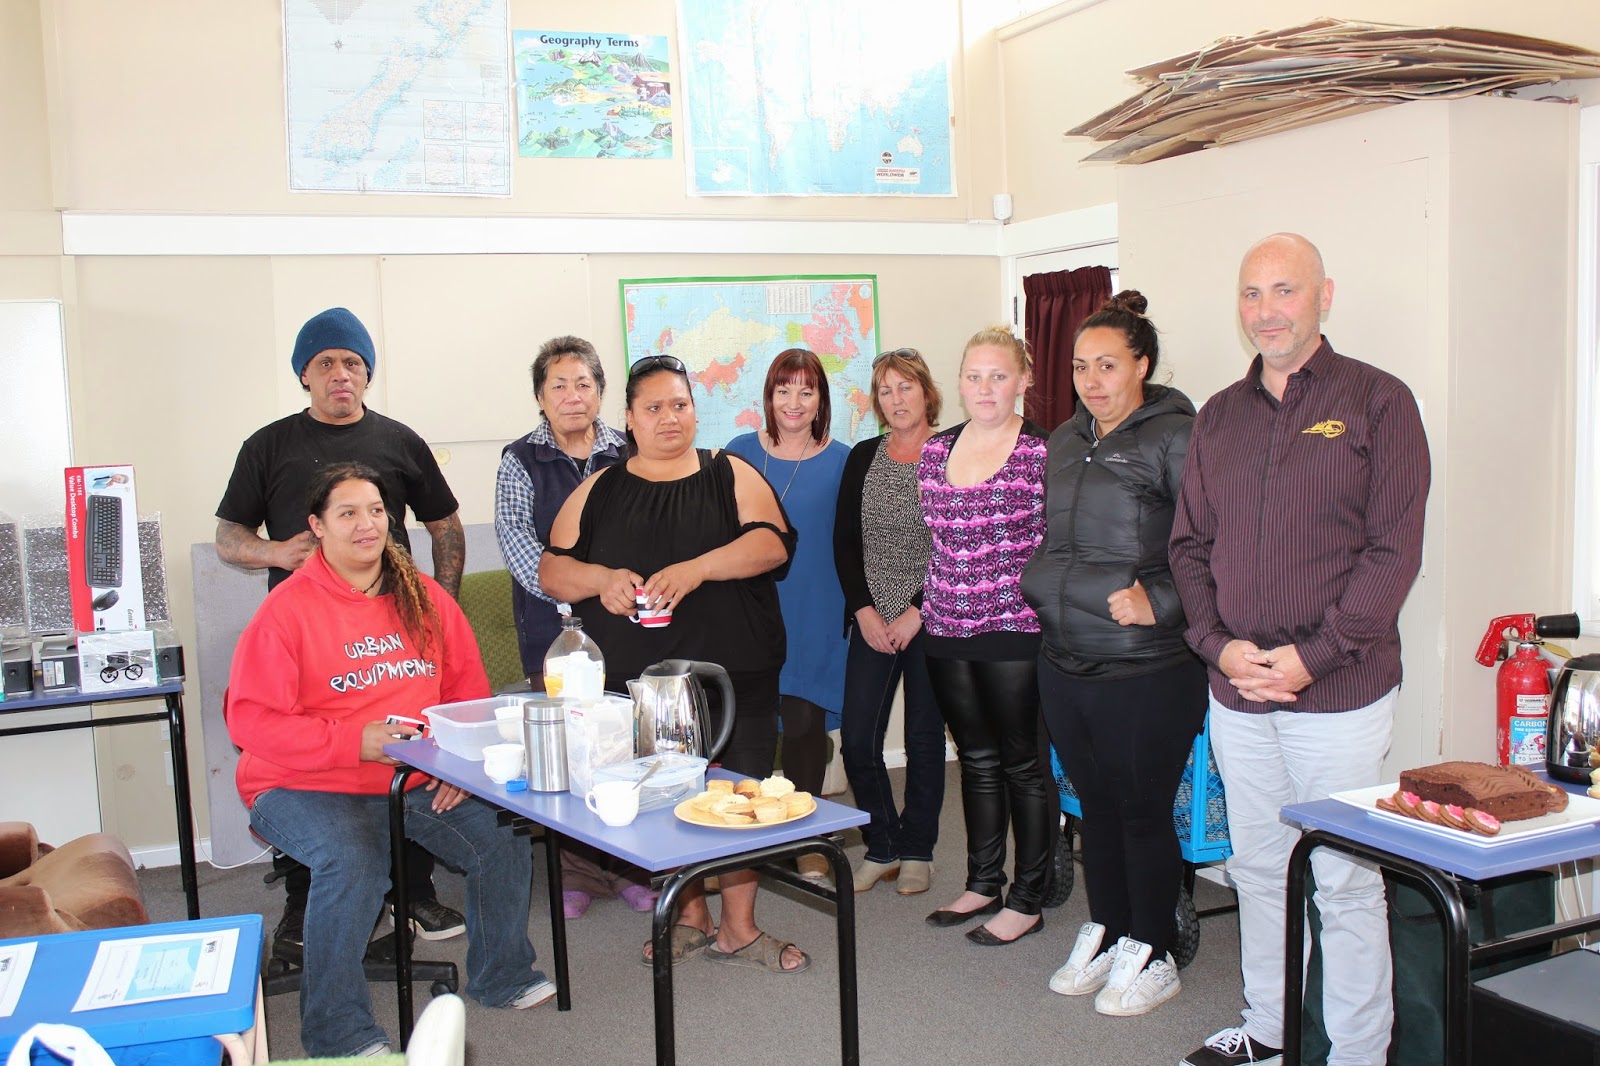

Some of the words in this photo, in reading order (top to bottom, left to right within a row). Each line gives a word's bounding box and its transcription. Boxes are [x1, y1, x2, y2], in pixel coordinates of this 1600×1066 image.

[540, 34, 602, 49] Geography
[607, 37, 639, 47] Terms
[127, 608, 135, 627] Genius
[344, 632, 405, 659] URBAN
[1514, 720, 1547, 728] CARBON
